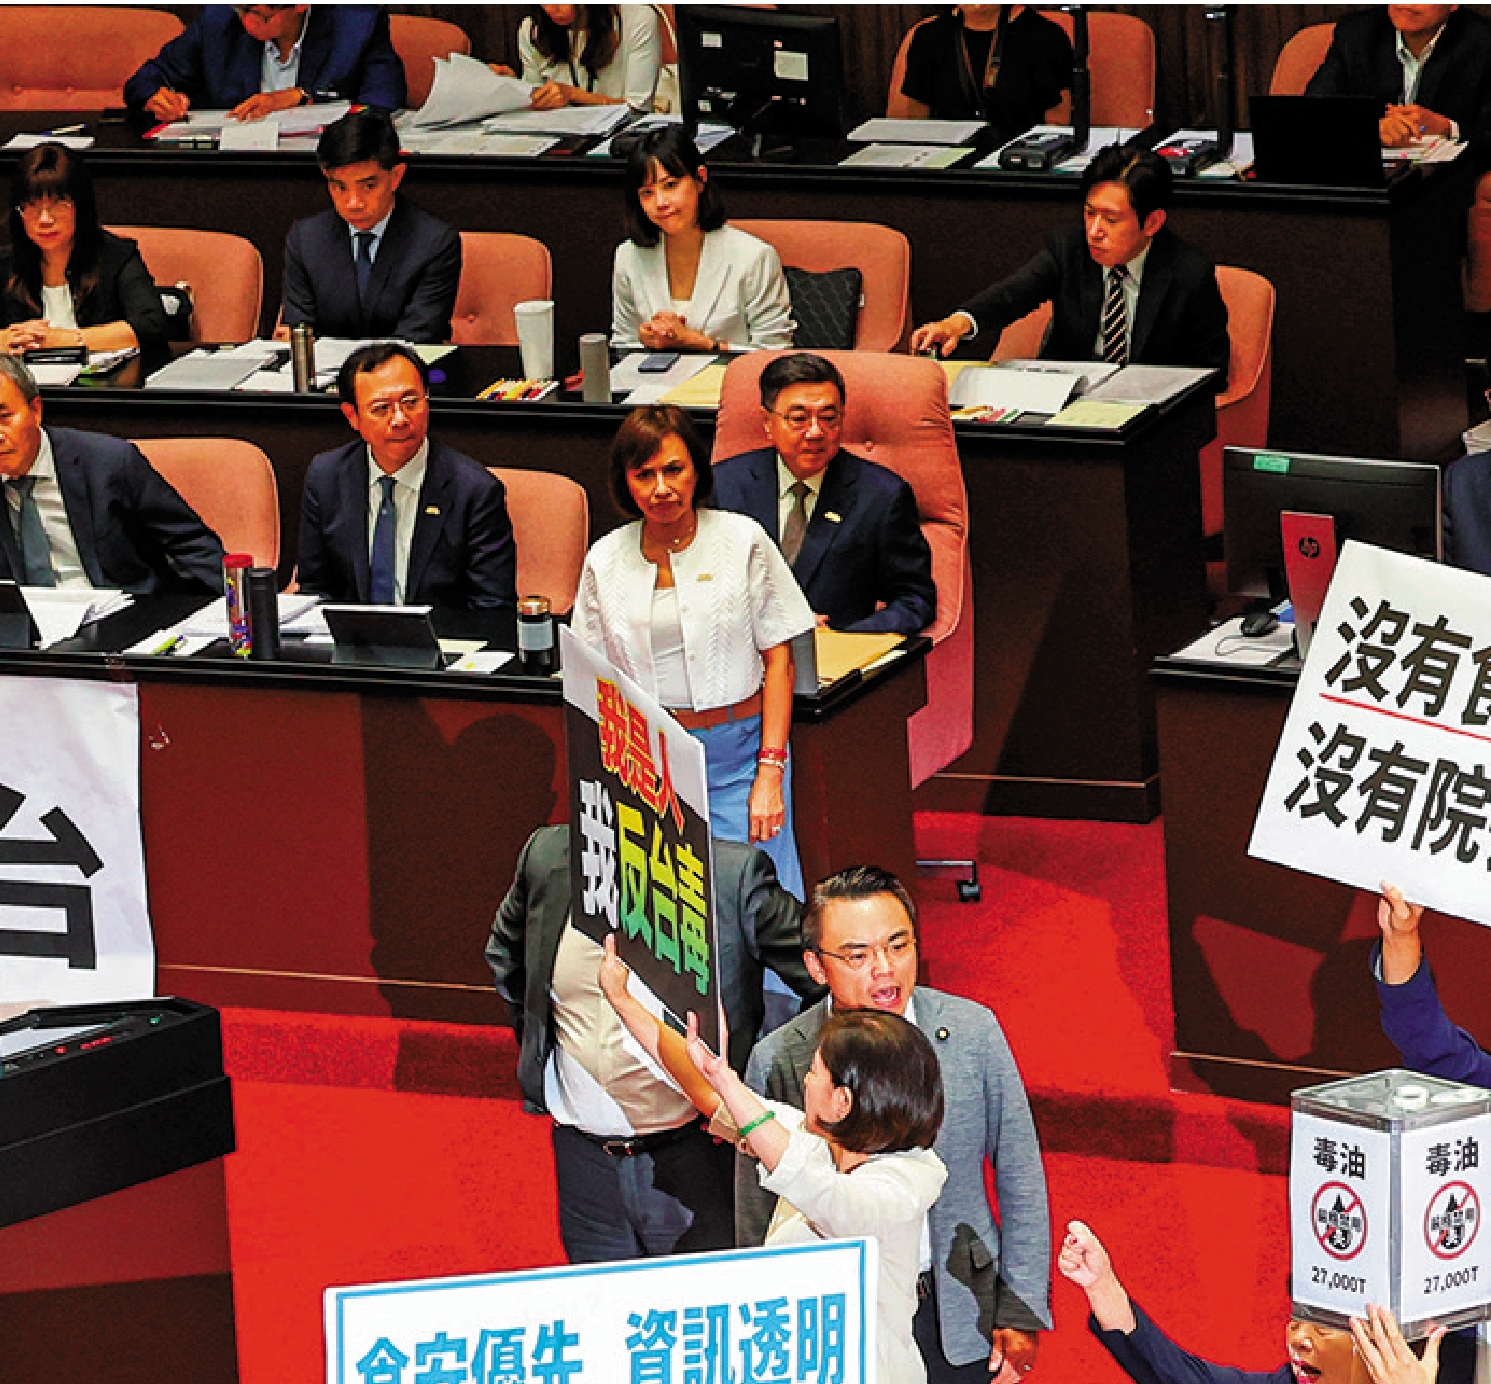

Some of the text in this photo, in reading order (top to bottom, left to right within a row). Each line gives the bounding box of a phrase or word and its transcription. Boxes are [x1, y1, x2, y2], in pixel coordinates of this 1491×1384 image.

[597, 678, 685, 834] 我是人
[579, 779, 710, 996] 我反台毒
[1312, 1136, 1367, 1180] 毒油
[1425, 1136, 1479, 1176] 毒油
[1311, 1266, 1367, 1294] 27,000T
[1424, 1265, 1479, 1294] 27,000T
